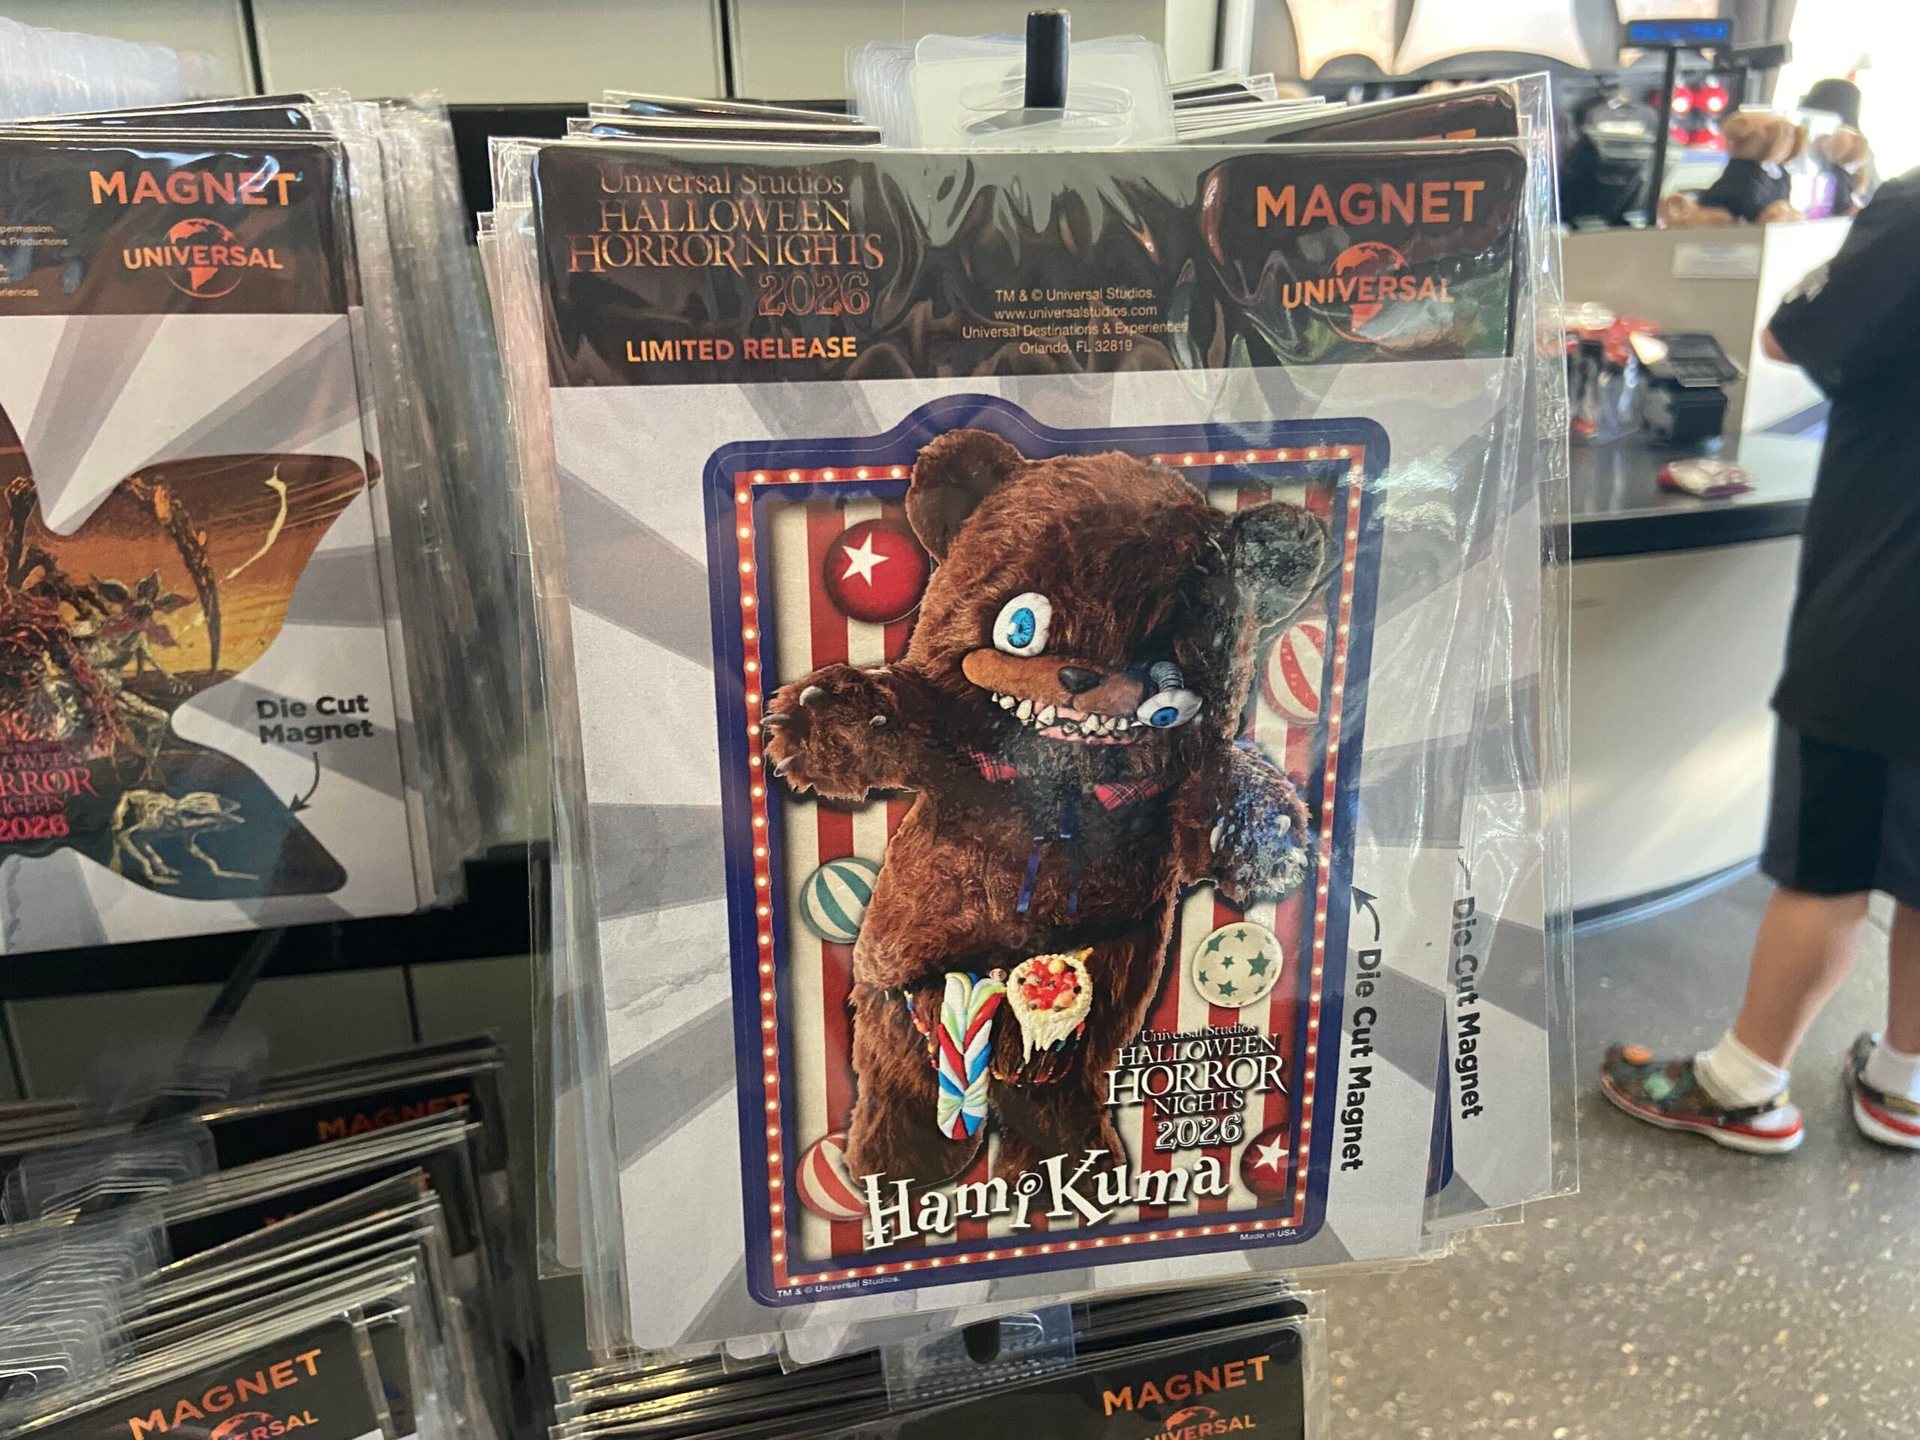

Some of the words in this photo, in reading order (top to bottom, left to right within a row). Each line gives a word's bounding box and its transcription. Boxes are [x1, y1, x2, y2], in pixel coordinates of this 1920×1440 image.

[90, 170, 297, 206] MAGNET
[600, 167, 731, 195] Universal
[740, 167, 844, 195] Studios
[600, 199, 850, 233] HALLOWEEN
[1256, 180, 1486, 228] MAGNET
[123, 246, 283, 270] UNIVERSAL
[567, 234, 744, 277] HORROR
[743, 232, 885, 270] NIGHTS
[758, 271, 870, 316] 2026
[995, 290, 1015, 302] TM
[1019, 290, 1028, 302] &
[1046, 288, 1103, 301] Universal
[1106, 287, 1156, 300] Studios.
[1281, 275, 1455, 310] UNIVERSAL
[994, 305, 1158, 320] www.universalstudios.com
[962, 325, 1020, 339] Universal
[1023, 324, 1099, 338] Destinations
[1103, 323, 1111, 335] &
[1115, 321, 1189, 336] Experiences
[626, 338, 735, 363] LIMITED
[743, 335, 858, 360] RELEASE
[1019, 342, 1071, 355] Orlando,
[1076, 341, 1090, 353] FL
[1095, 340, 1133, 352] 32819
[257, 698, 308, 719] Die
[316, 694, 370, 714] Cut
[260, 720, 374, 744] Magnet
[0, 768, 99, 797] RROR
[1453, 896, 1476, 947] Die
[1356, 949, 1382, 998] Die
[1454, 954, 1479, 1007] Cut
[1141, 1026, 1203, 1043] Universal
[1207, 1022, 1256, 1037] Studios
[1350, 1005, 1377, 1058] Cut
[1117, 1033, 1278, 1066] HALLOWEEN
[1455, 1011, 1483, 1119] Magnet
[1103, 1055, 1289, 1105] HORROR
[1152, 1090, 1244, 1116] NIGHTS
[1340, 1066, 1373, 1172] Magnet
[1154, 1112, 1242, 1150] 2026
[1240, 1232, 1265, 1240] Made
[1277, 1229, 1297, 1237] USA
[815, 1281, 860, 1292] Universal
[128, 1348, 322, 1440] MAGNET
[1102, 1355, 1270, 1416] MAGNET
